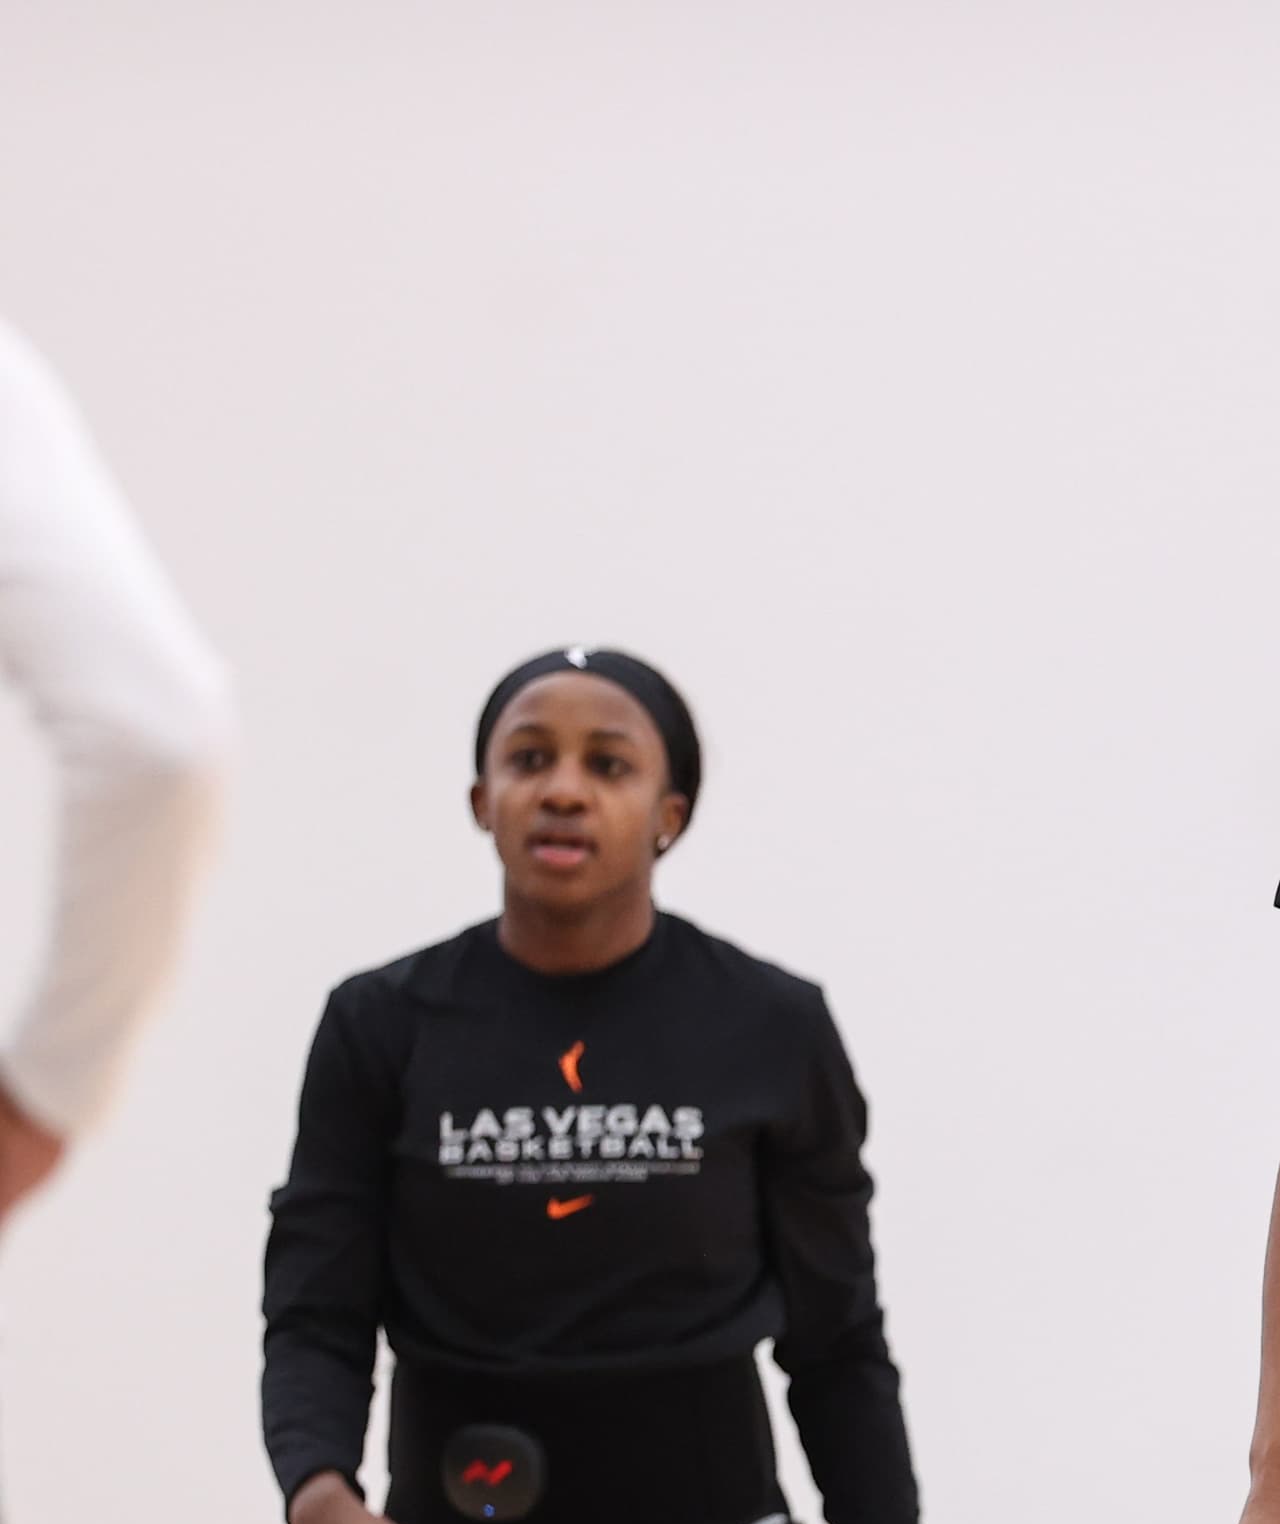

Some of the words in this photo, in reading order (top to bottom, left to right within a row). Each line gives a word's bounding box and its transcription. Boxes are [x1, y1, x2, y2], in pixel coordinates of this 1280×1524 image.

[439, 1106, 536, 1144] LAS
[541, 1103, 704, 1140] VEGAS
[438, 1135, 704, 1165] BASKETBALL
